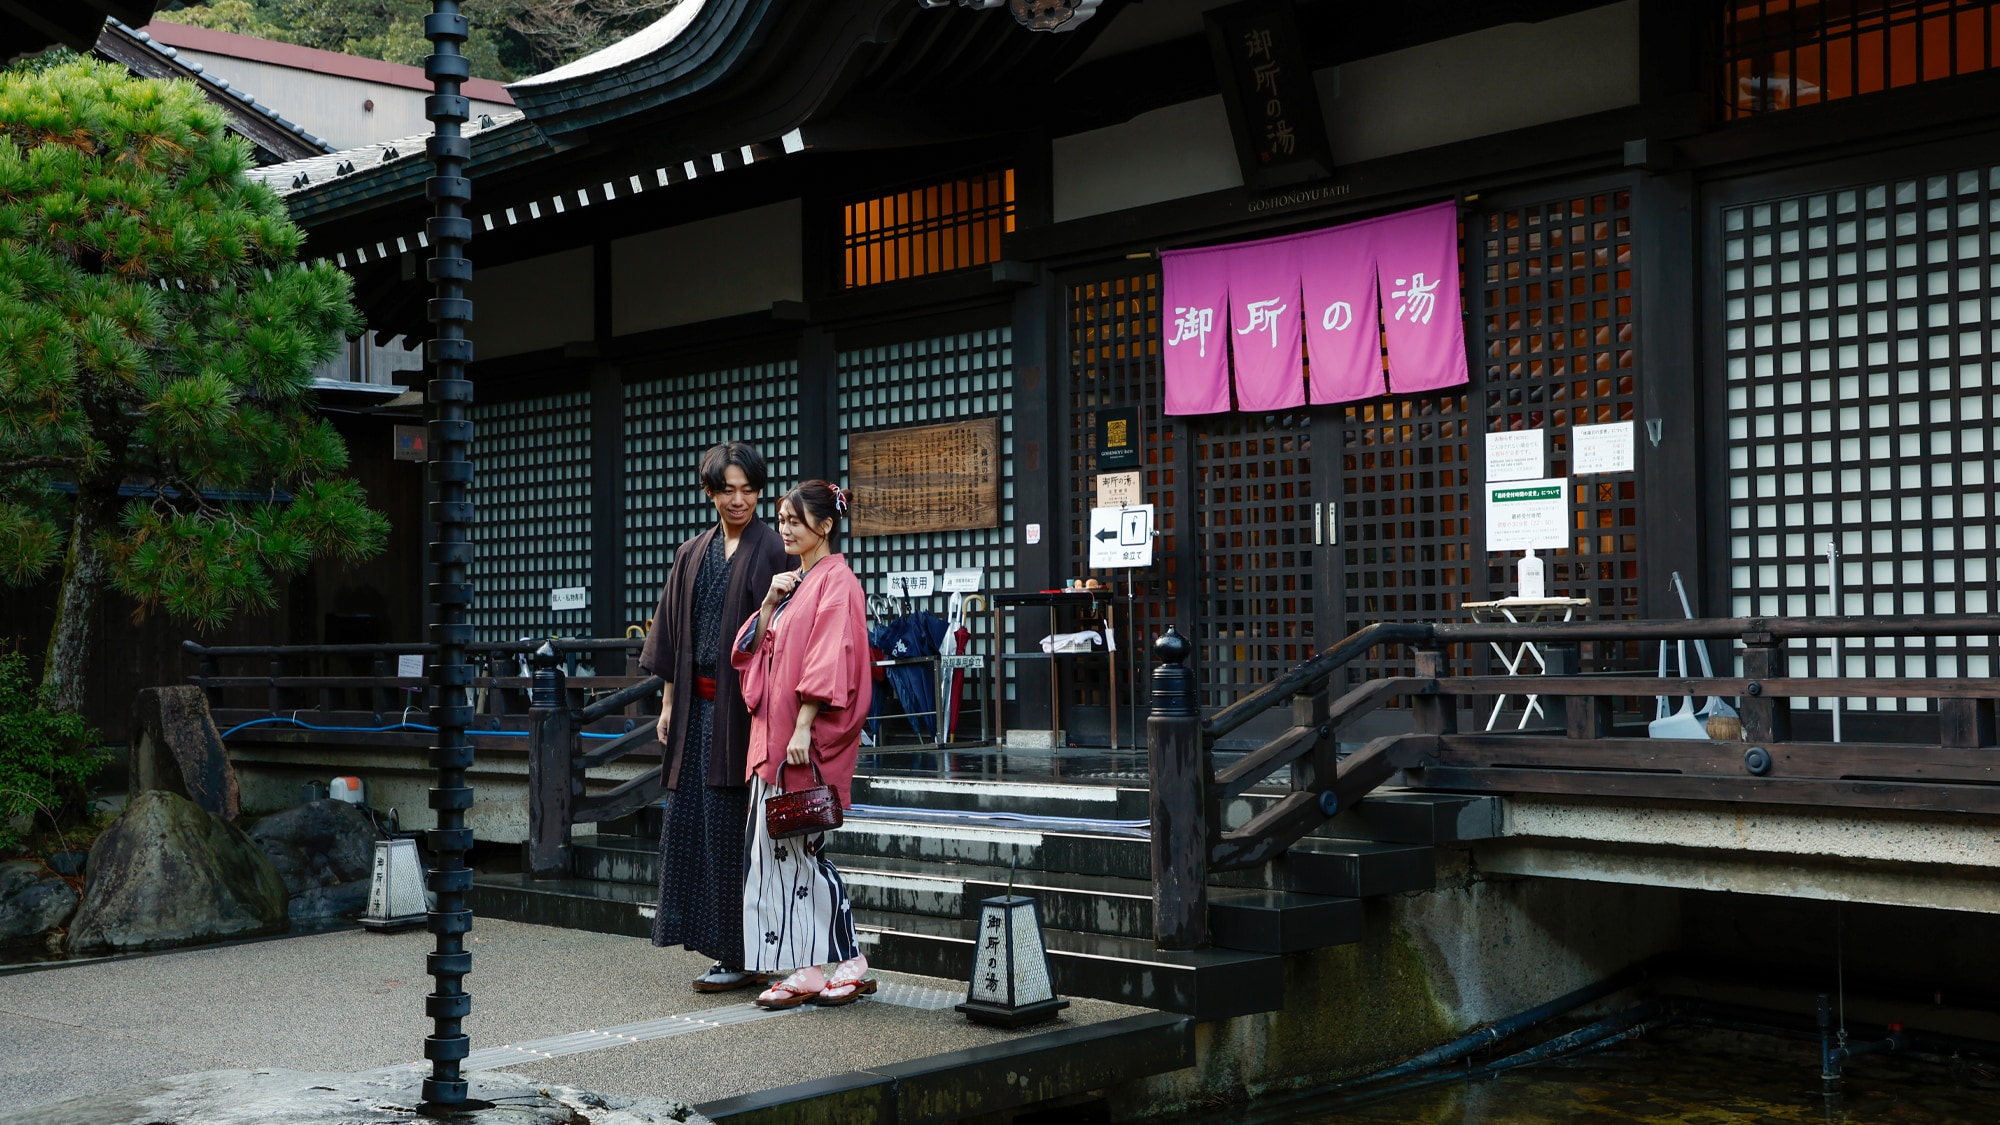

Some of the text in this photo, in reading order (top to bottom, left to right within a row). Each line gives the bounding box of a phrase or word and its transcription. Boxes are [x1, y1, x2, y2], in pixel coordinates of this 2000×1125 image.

[1244, 28, 1295, 155] 御所の湯
[1248, 184, 1350, 212] GOSHONOYU BATH
[1168, 272, 1440, 358] 御所の湯
[1123, 551, 1142, 560] 傘立て
[985, 915, 1001, 993] 御所の湯
